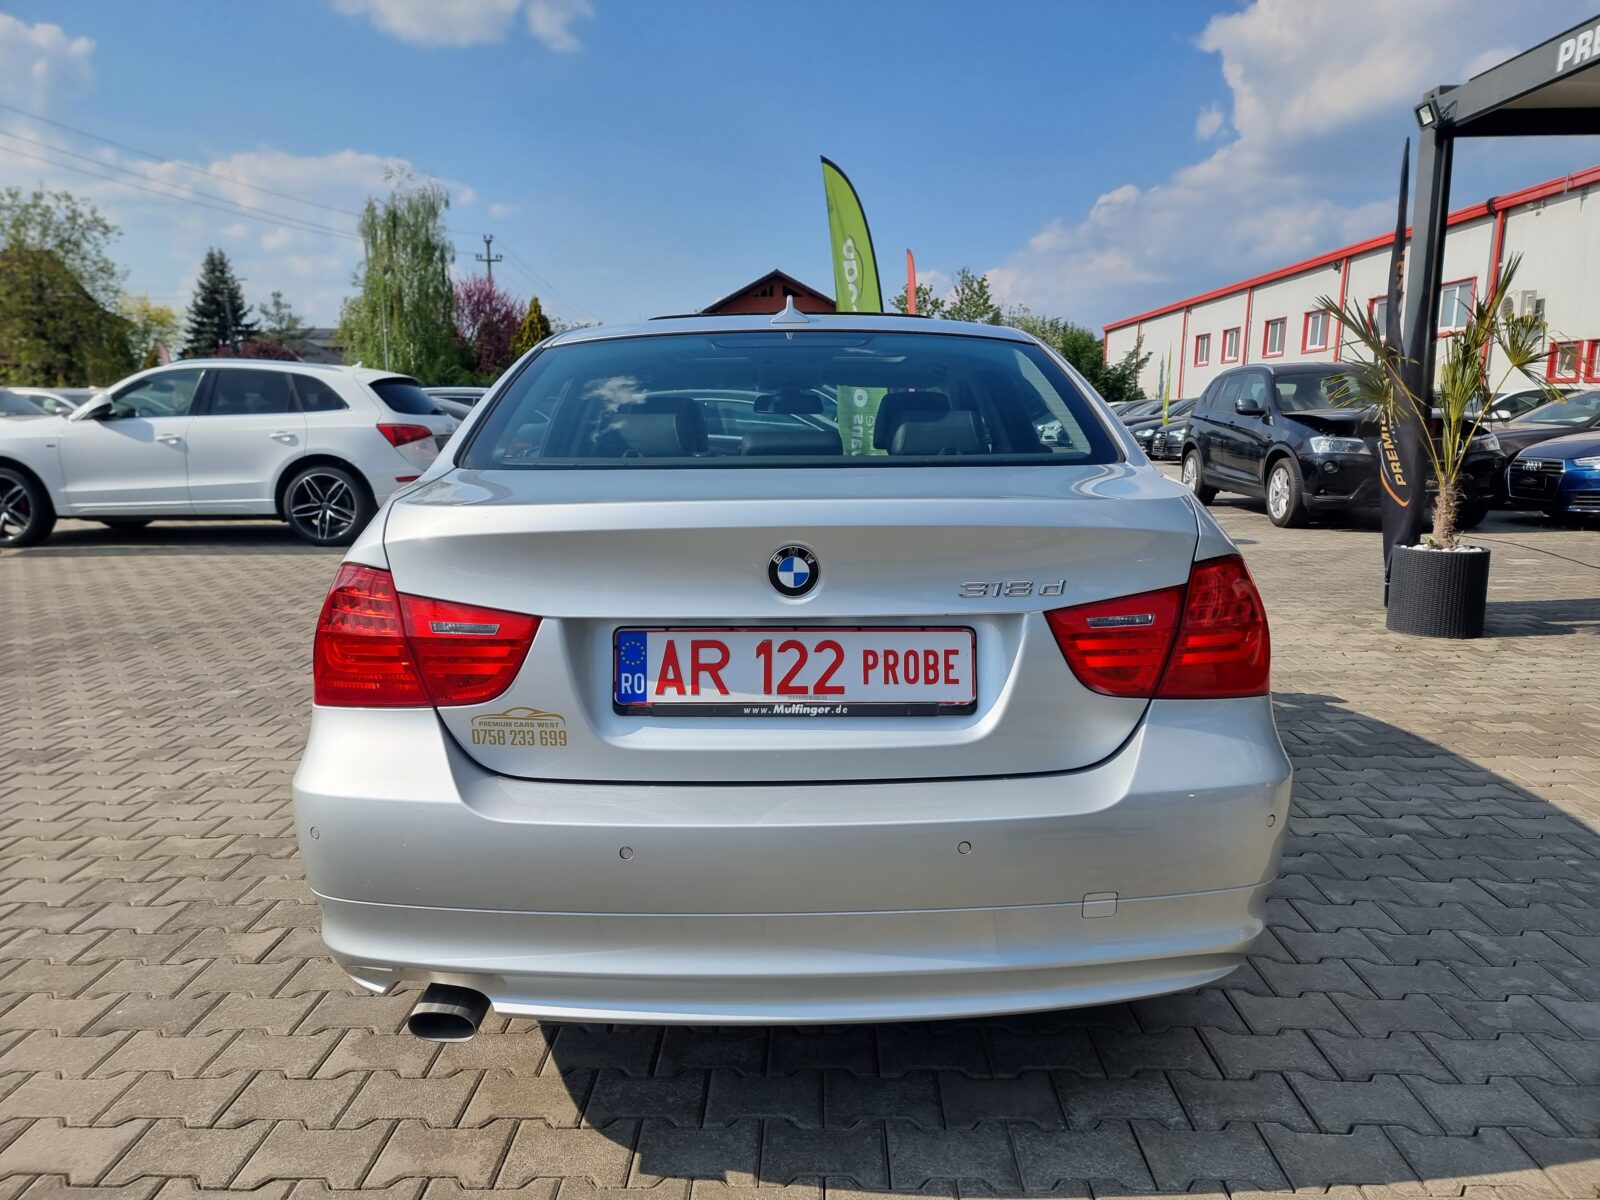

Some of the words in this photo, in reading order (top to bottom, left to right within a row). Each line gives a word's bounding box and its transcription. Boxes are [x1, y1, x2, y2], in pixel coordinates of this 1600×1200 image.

[655, 639, 731, 696] AR
[756, 639, 845, 695] 122
[863, 649, 960, 685] PROBE
[620, 673, 645, 695] RO
[471, 729, 506, 746] 0758
[510, 730, 535, 746] 233
[540, 731, 567, 747] 699
